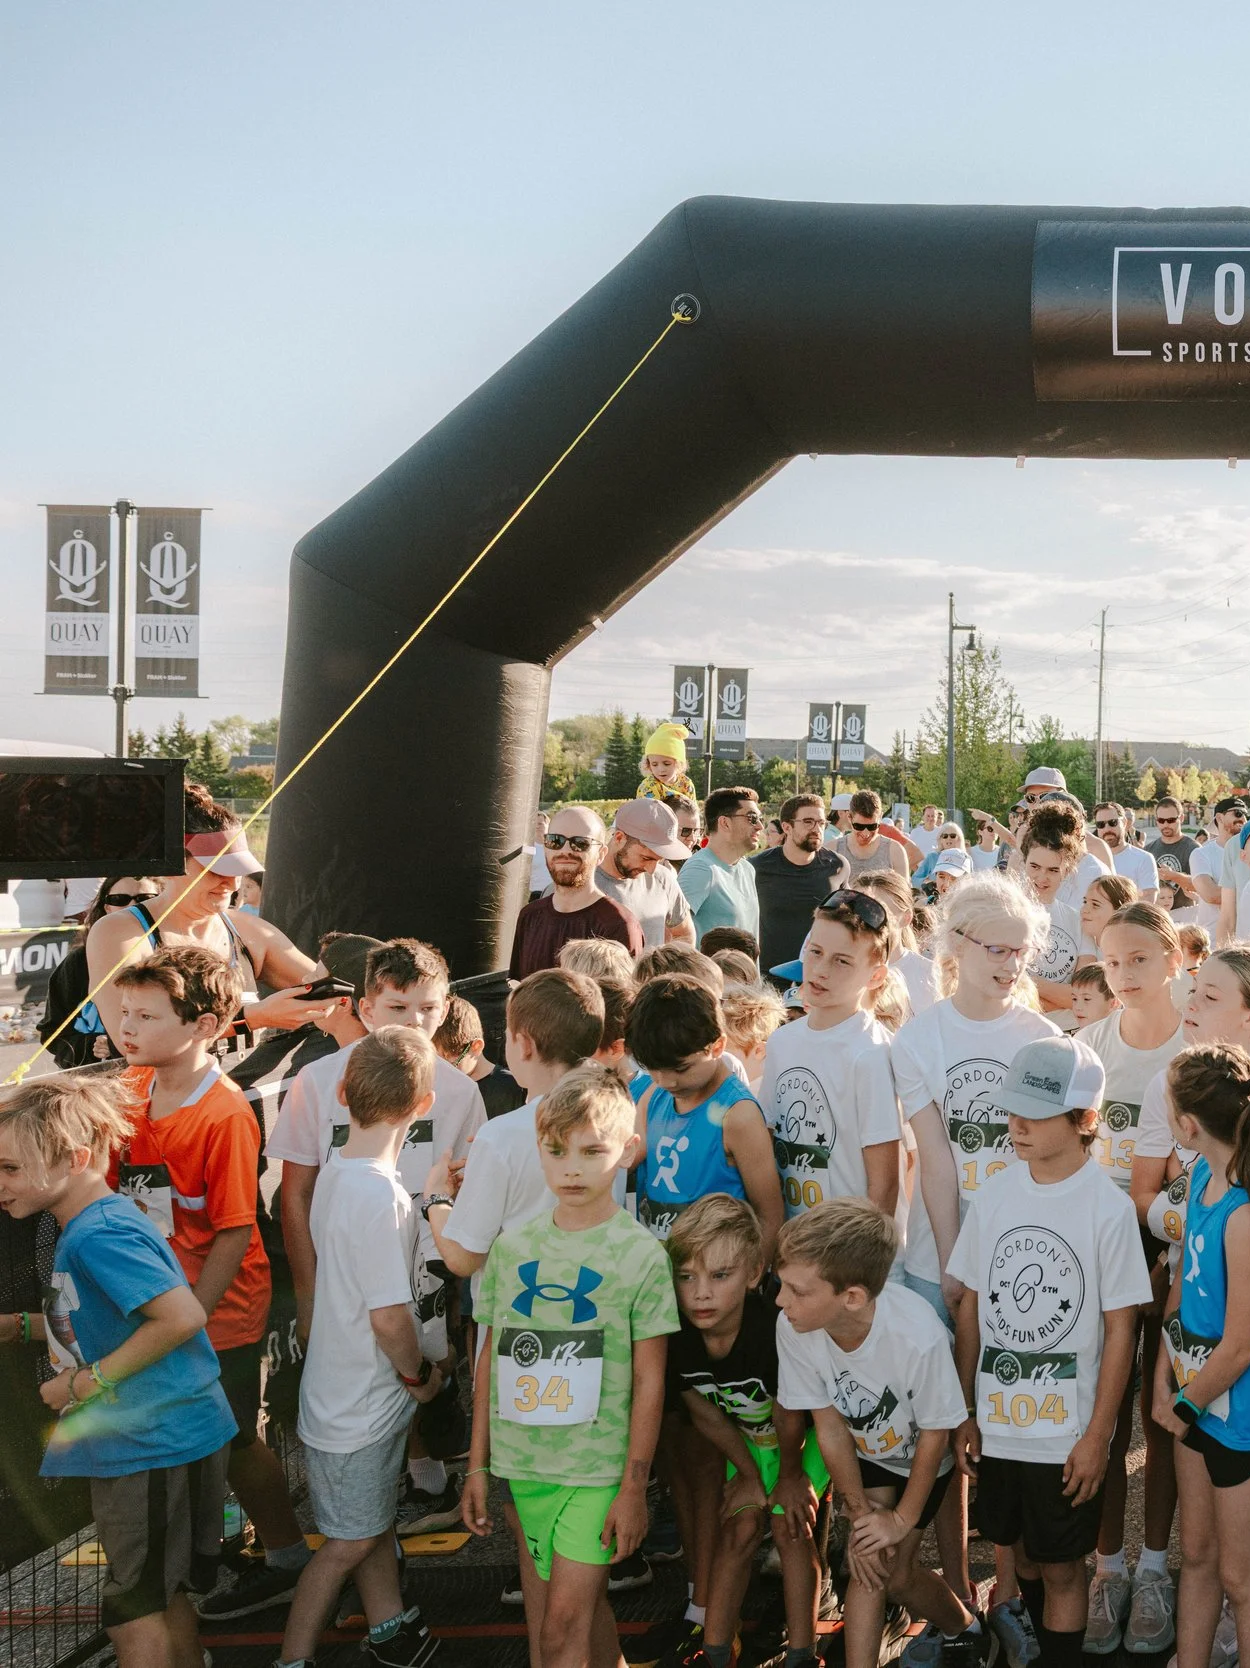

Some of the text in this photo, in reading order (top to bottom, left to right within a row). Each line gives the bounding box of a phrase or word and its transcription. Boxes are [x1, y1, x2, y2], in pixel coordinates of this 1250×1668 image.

[50, 622, 104, 643] QUAY
[141, 624, 193, 645] QUAY
[1044, 971, 1058, 979] FUN
[1058, 962, 1071, 976] RUN
[805, 1120, 817, 1129] 5TH
[794, 1152, 815, 1174] 1K
[995, 1238, 1072, 1277] GORDON'S
[999, 1280, 1059, 1294] OCT 5TH
[995, 1307, 1064, 1343] KIDS FUN RUN
[551, 1340, 586, 1367] 1K
[1029, 1361, 1061, 1387] 1K
[513, 1374, 574, 1413] 34
[987, 1391, 1069, 1428] 104
